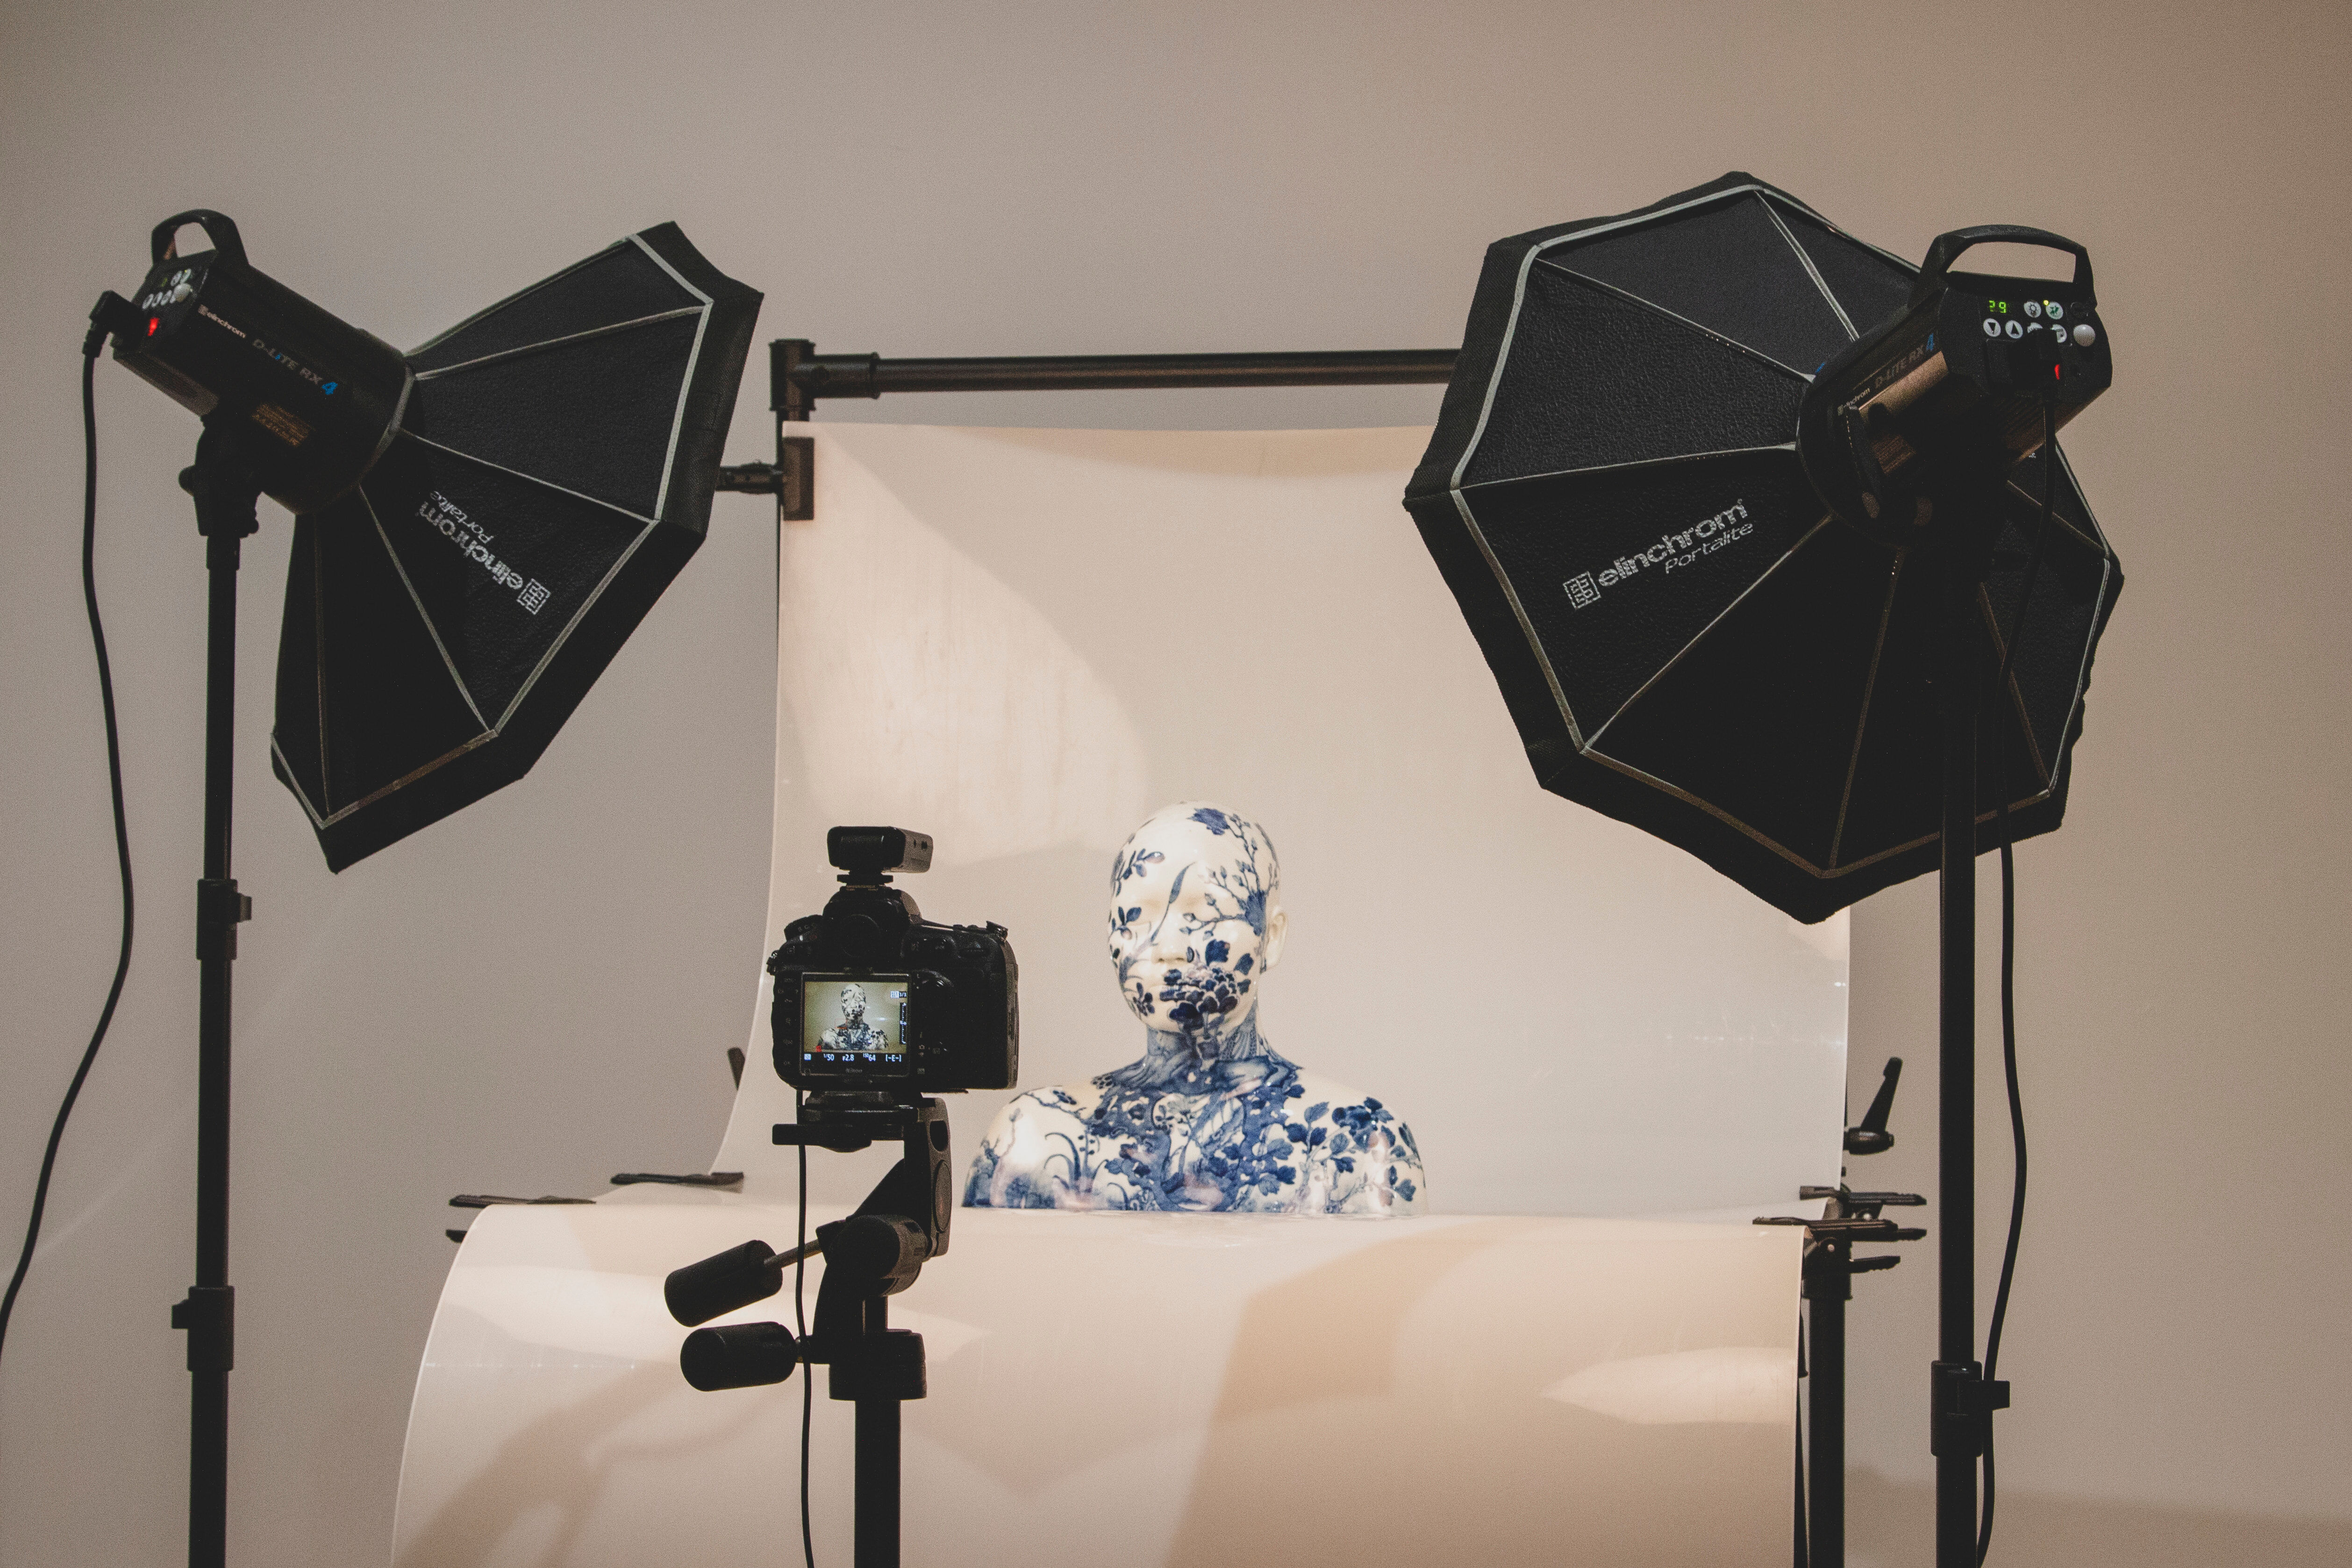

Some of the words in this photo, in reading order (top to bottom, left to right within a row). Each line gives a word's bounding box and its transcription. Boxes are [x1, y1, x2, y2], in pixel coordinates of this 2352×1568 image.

[207, 312, 246, 339] elinchrom
[420, 501, 523, 589] elinchrom
[1598, 503, 1748, 587] elinchrom
